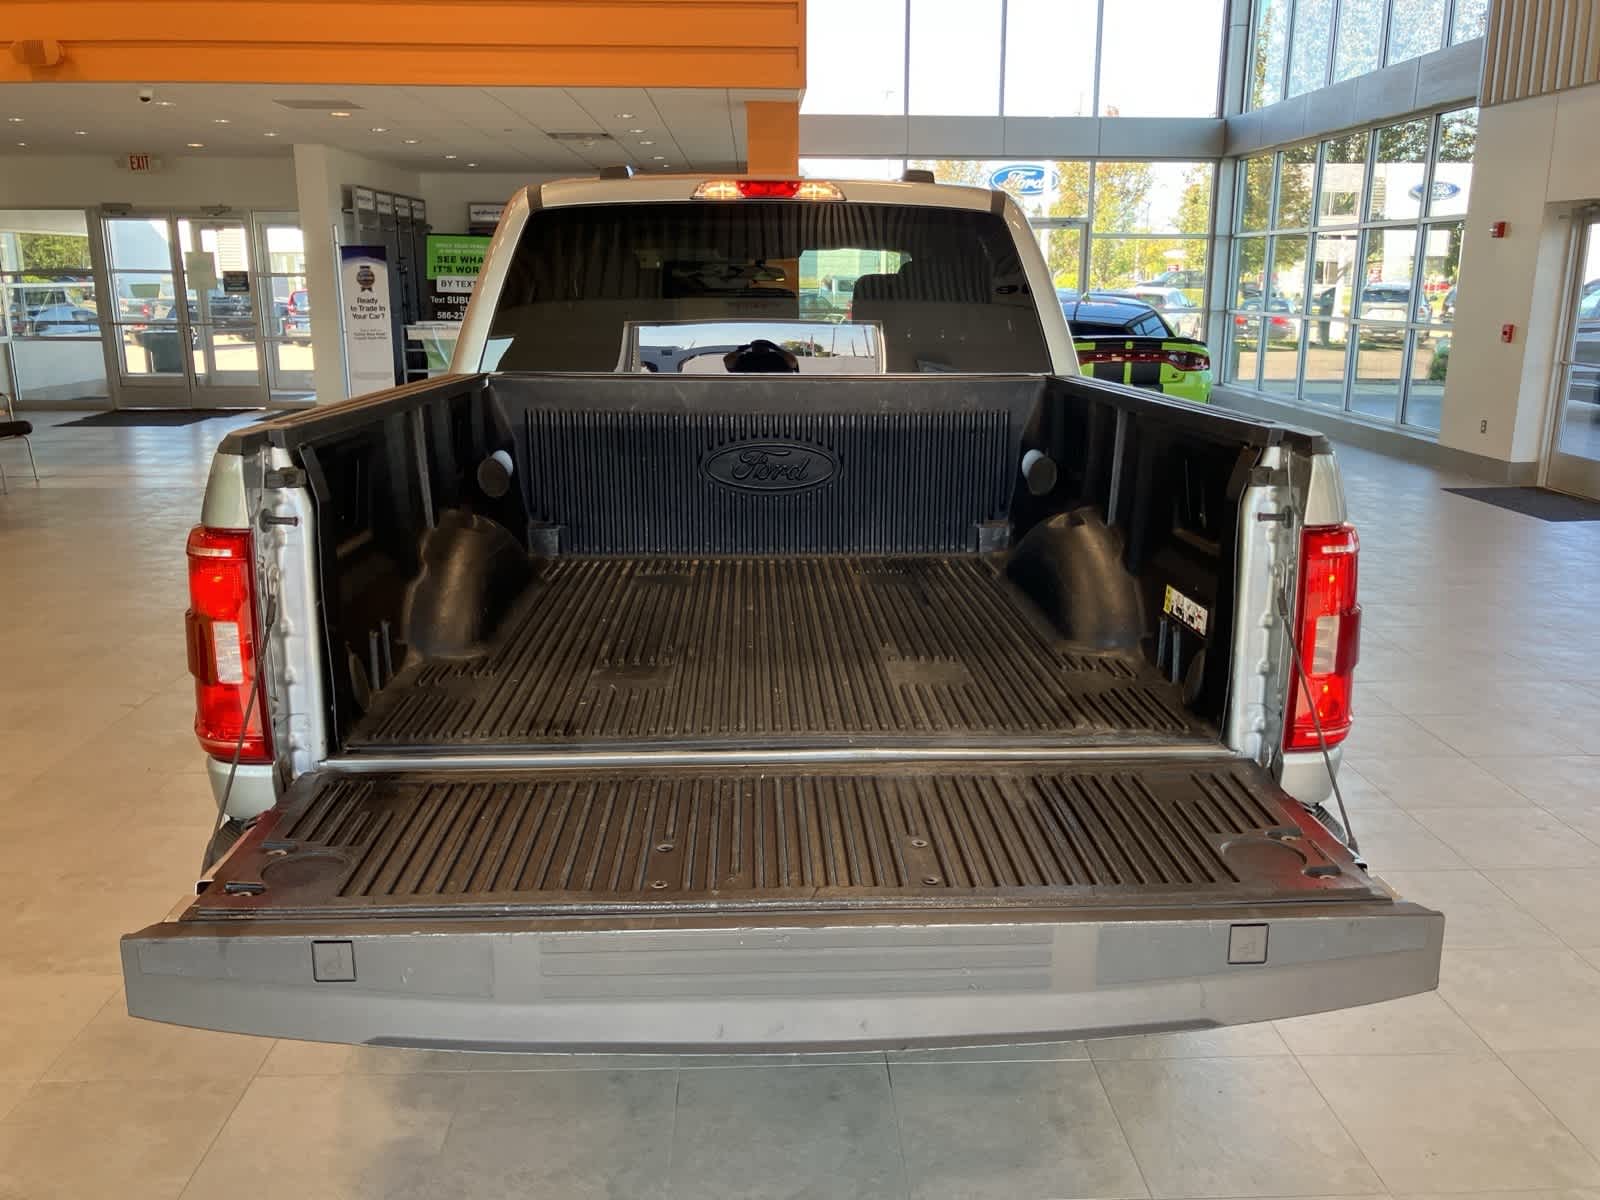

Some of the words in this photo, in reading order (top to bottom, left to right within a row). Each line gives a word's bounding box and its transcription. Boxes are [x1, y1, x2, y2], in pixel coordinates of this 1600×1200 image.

[130, 156, 149, 170] EXIT
[436, 255, 456, 264] SEE
[460, 255, 484, 264] WHA
[433, 264, 453, 273] IT'S
[455, 265, 481, 274] WOR
[440, 280, 453, 288] BY
[356, 296, 378, 305] Ready
[430, 295, 446, 304] Text
[446, 295, 471, 304] SUBU
[350, 304, 358, 312] to
[358, 304, 378, 312] Trade
[352, 312, 367, 320] Your
[368, 312, 385, 320] Car?
[732, 448, 810, 480] Ford
